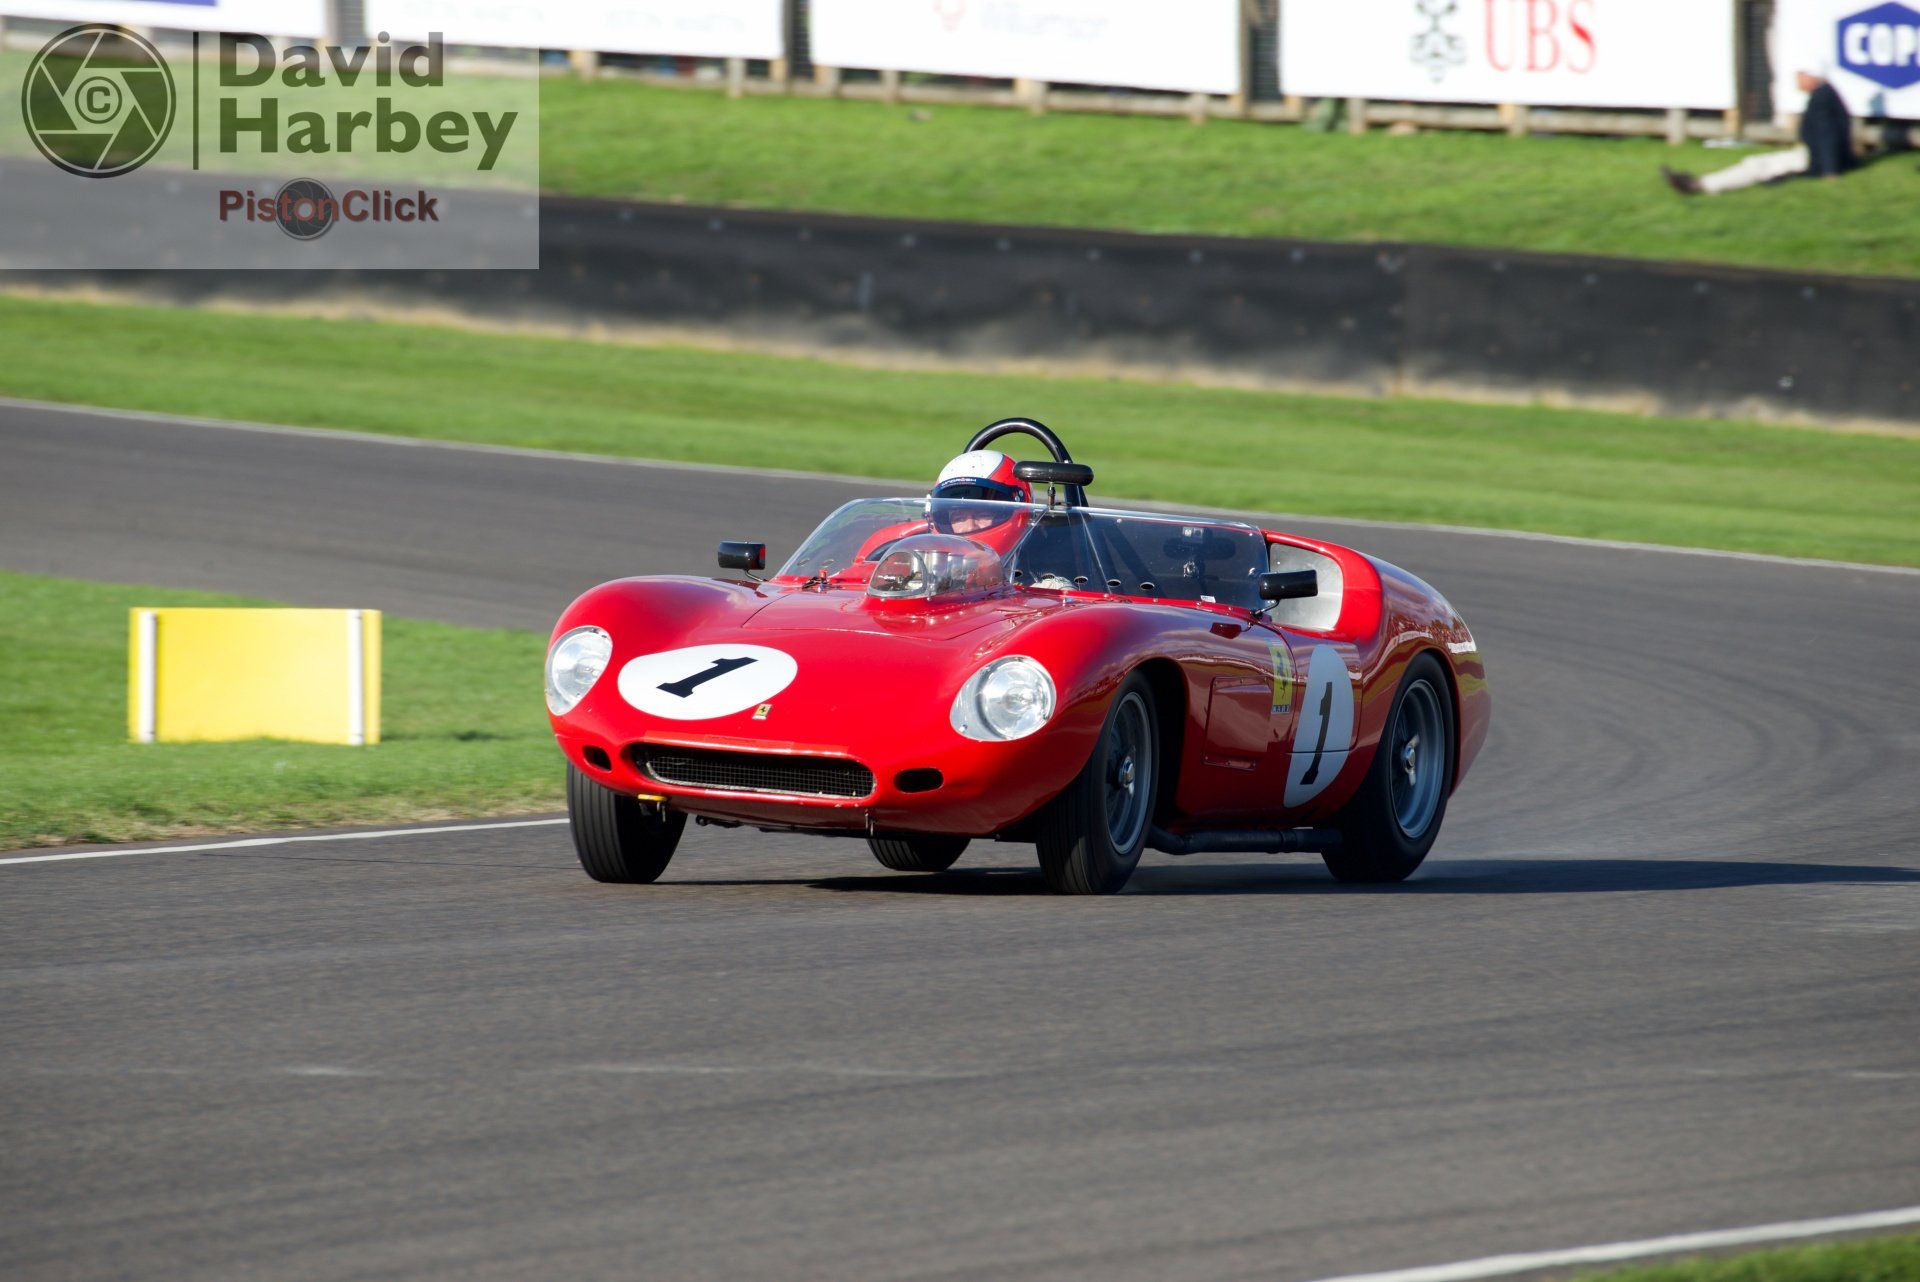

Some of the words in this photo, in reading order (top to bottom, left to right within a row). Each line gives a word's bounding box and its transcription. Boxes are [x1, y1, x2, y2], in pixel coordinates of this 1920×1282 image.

[1484, 0, 1598, 74] UBS
[1844, 22, 1920, 67] COP
[657, 656, 759, 699] 1
[1299, 681, 1333, 786] 1
